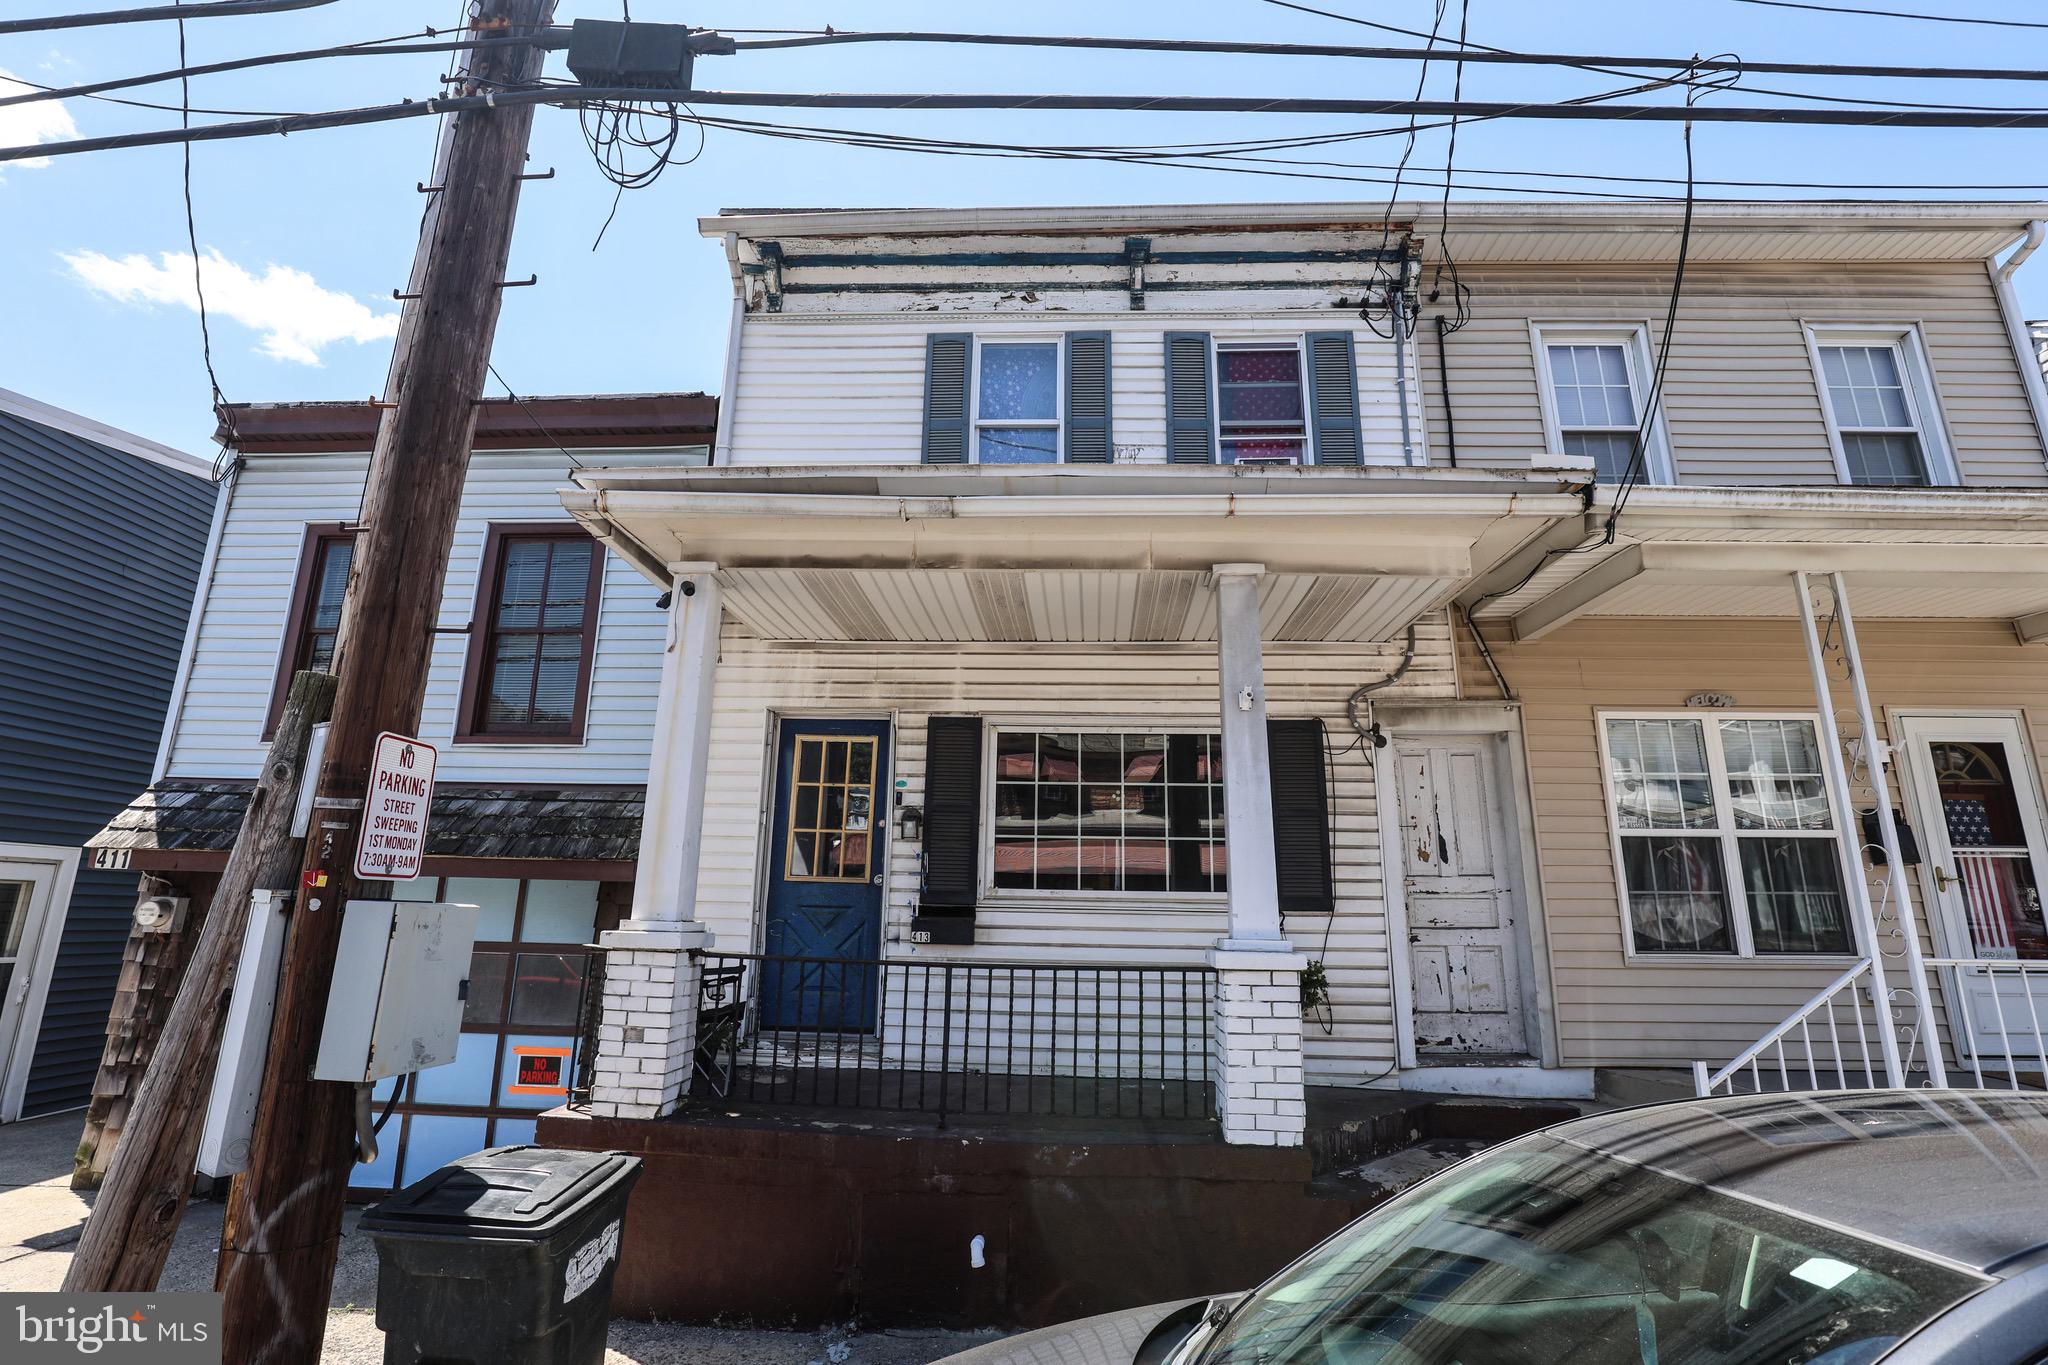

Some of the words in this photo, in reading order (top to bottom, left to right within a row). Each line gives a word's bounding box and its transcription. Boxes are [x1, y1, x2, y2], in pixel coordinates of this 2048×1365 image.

[399, 748, 415, 769] NO
[378, 771, 427, 797] PARKING
[383, 798, 416, 815] STREET
[374, 816, 418, 833] SWEEPING
[368, 834, 384, 848] 1ST
[384, 835, 418, 851] MONDAY
[96, 849, 130, 868] 411
[363, 852, 416, 869] 7:30AM-9AM
[911, 932, 930, 942] 413
[533, 1058, 547, 1070] NO
[521, 1071, 558, 1083] PARKING
